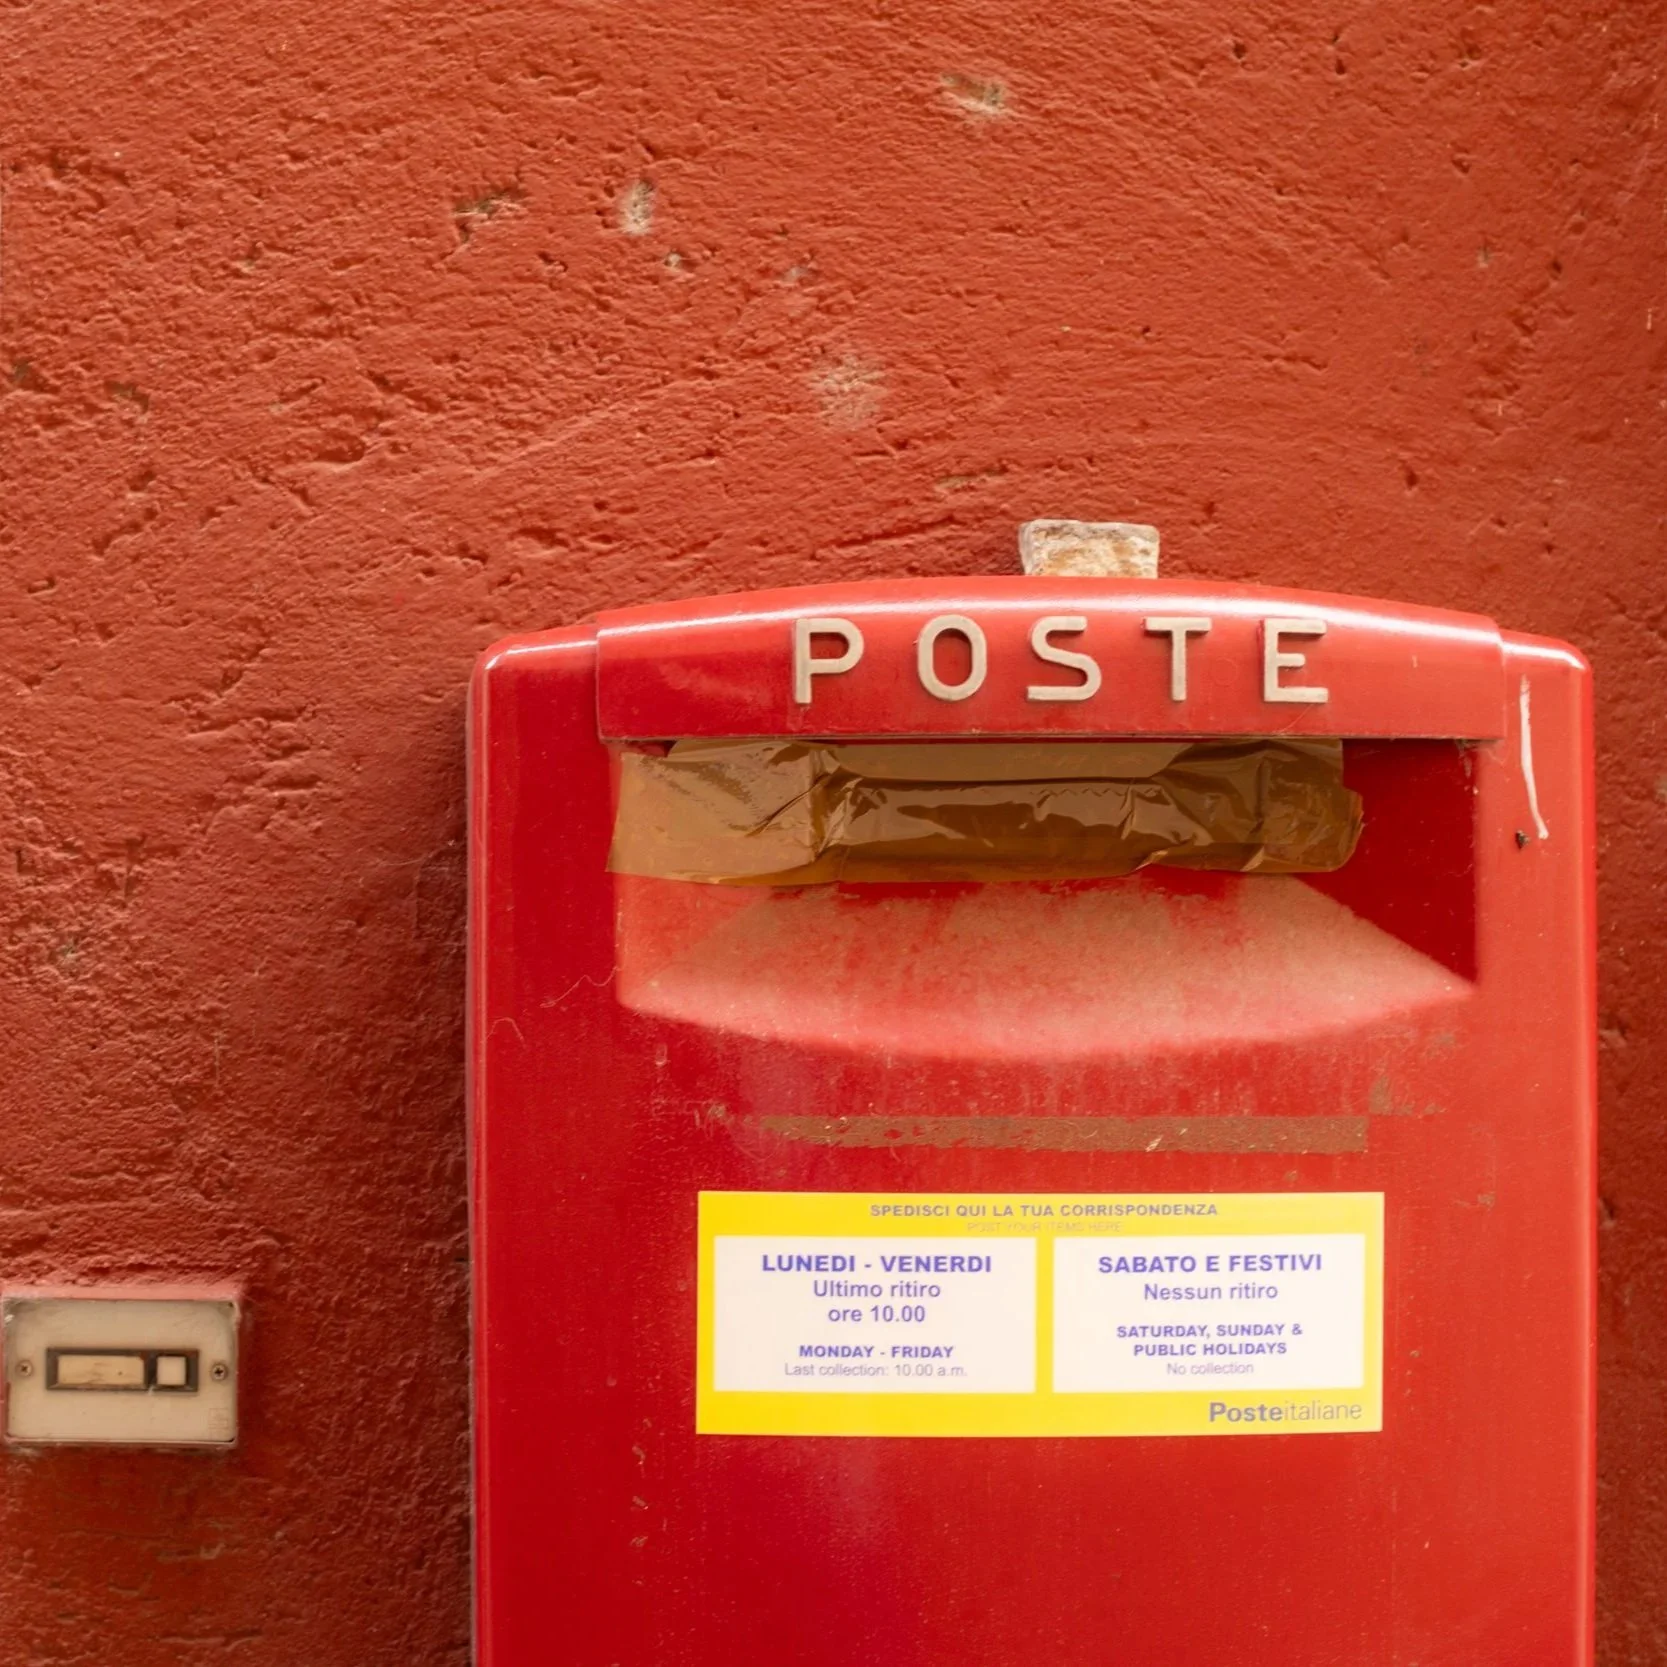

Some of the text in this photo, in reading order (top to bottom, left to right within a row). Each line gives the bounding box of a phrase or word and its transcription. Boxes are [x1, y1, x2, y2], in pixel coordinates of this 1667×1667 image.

[793, 614, 1329, 704] POSTE
[870, 1204, 1218, 1217] SPEDISCI QUI LA TUA CORRISPONDENZA
[1099, 1254, 1322, 1273] SABATO E FESTIVI
[814, 1280, 941, 1297] Ultimo ritiro
[1144, 1283, 1278, 1300] Nessun ritiro
[828, 1305, 925, 1322] ore 10.00
[1117, 1324, 1303, 1339] SATURDAY, SUNDAY &
[799, 1346, 874, 1358] MONDAY
[892, 1346, 953, 1358] FRIDAY
[1134, 1342, 1287, 1356] PUBLIC HOLIDAYS
[785, 1363, 967, 1377] Last collection: 10.00 a.m.
[1167, 1362, 1253, 1374] No collection
